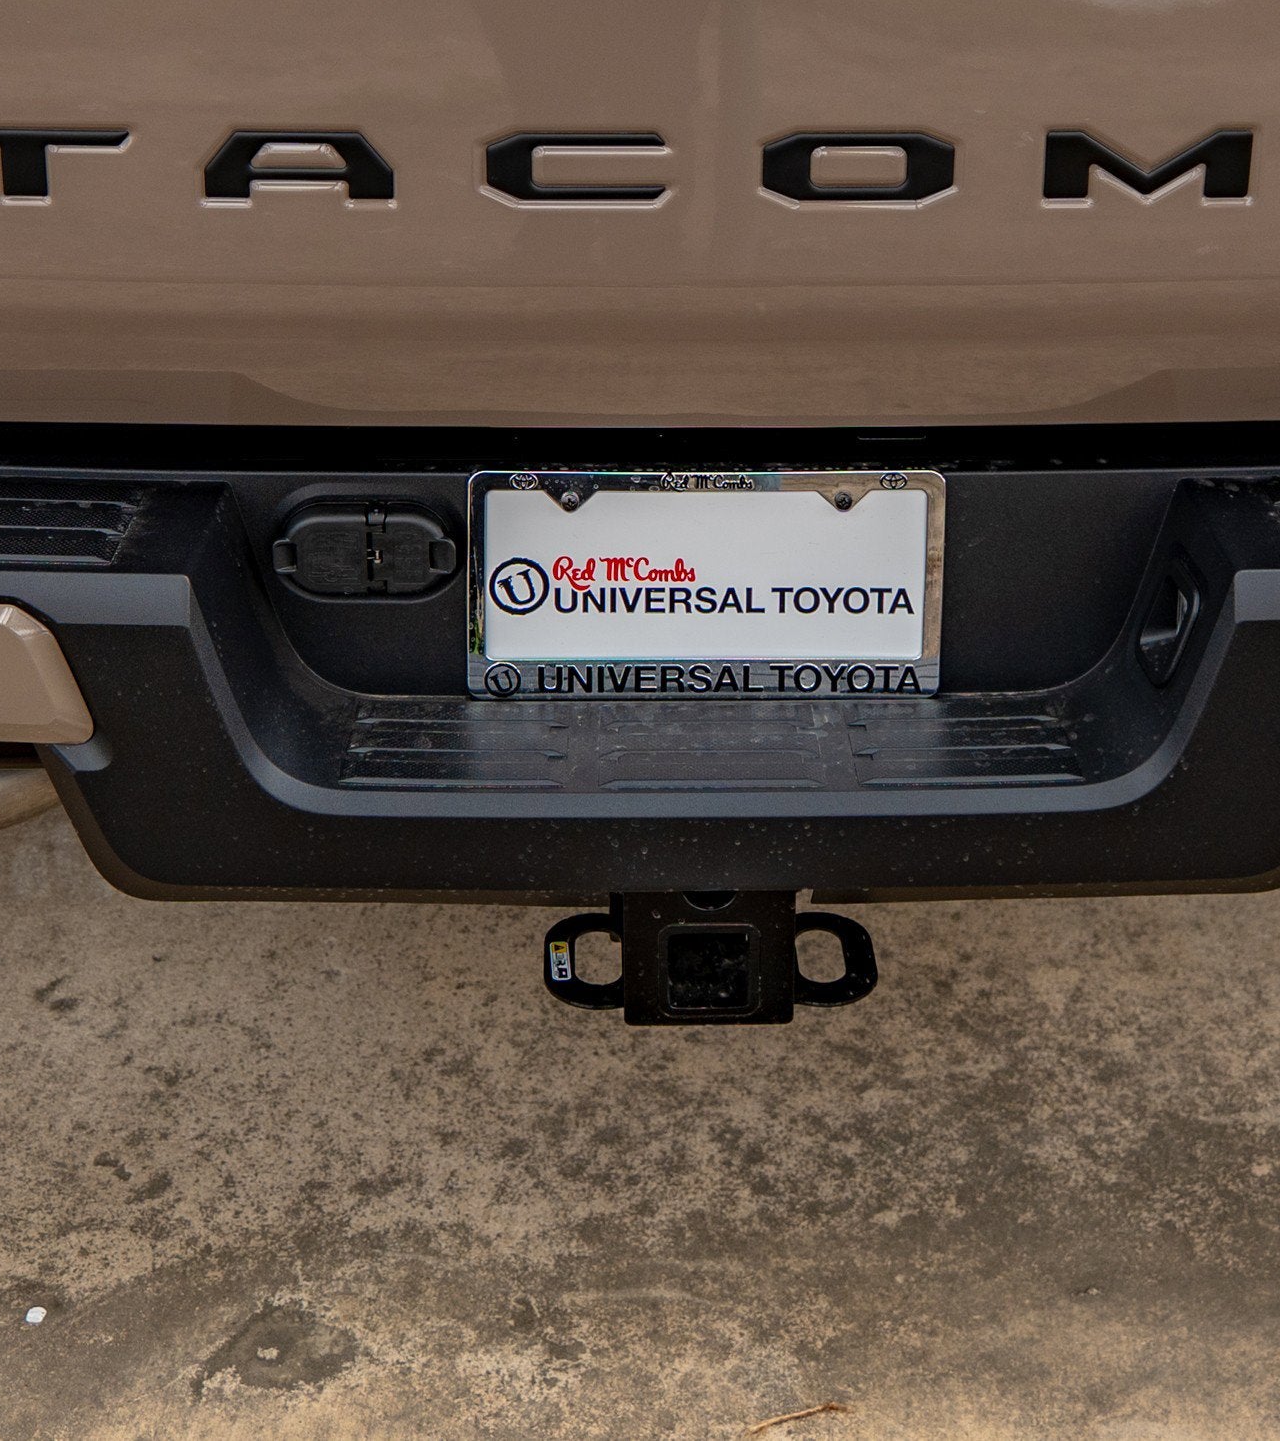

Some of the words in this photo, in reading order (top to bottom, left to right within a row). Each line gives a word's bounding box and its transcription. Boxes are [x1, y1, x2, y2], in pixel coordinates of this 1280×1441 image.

[661, 472, 690, 492] Red
[690, 474, 754, 490] McCombs
[552, 555, 596, 591] Red
[599, 556, 697, 583] McCombs
[553, 586, 766, 614] UNIVERSAL
[771, 586, 915, 615] TOYOTA
[537, 663, 765, 693] UNIVERSAL
[769, 663, 922, 693] TOYOTA
